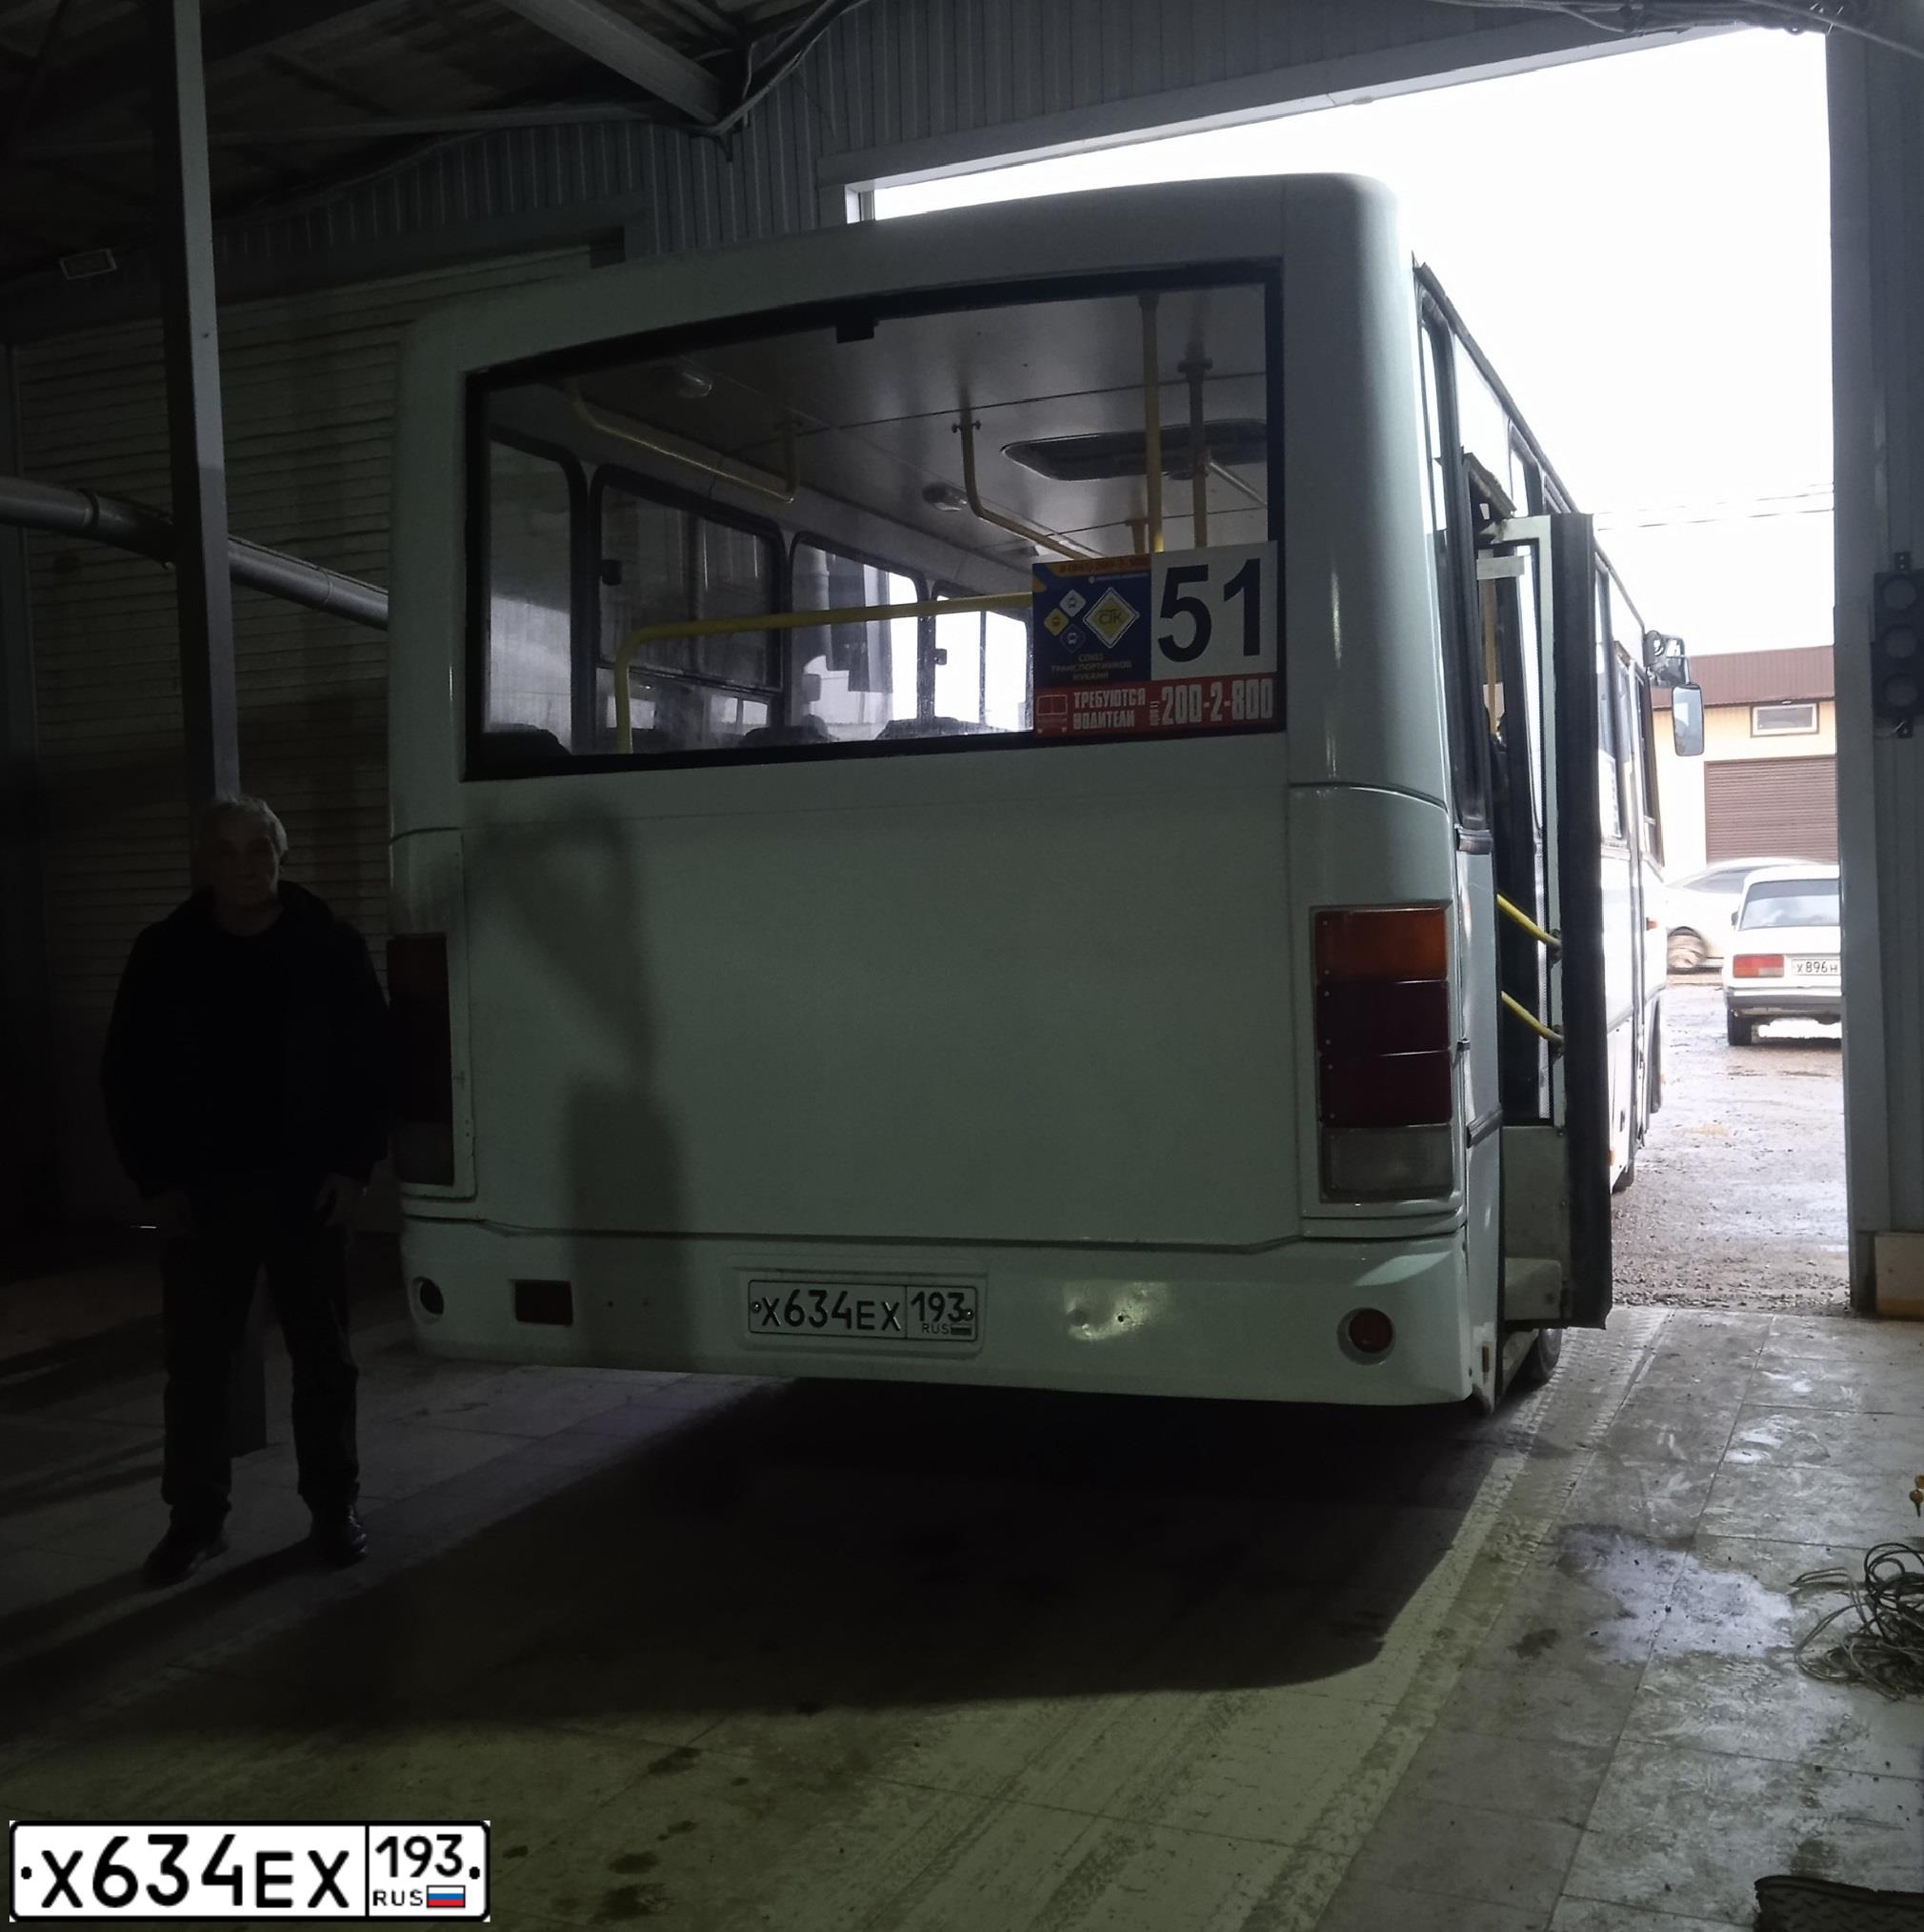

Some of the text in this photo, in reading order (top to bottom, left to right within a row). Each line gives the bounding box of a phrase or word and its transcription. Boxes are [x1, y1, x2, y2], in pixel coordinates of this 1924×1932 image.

[1157, 558, 1260, 662] 51
[1072, 687, 1146, 709] ТРЕБУЮТСЯ
[1161, 677, 1273, 726] 200-2-800
[1072, 710, 1135, 731] ВОДИТЕЛИ
[761, 1289, 965, 1332] Х634ЕХ 193
[921, 1322, 950, 1335] RUS
